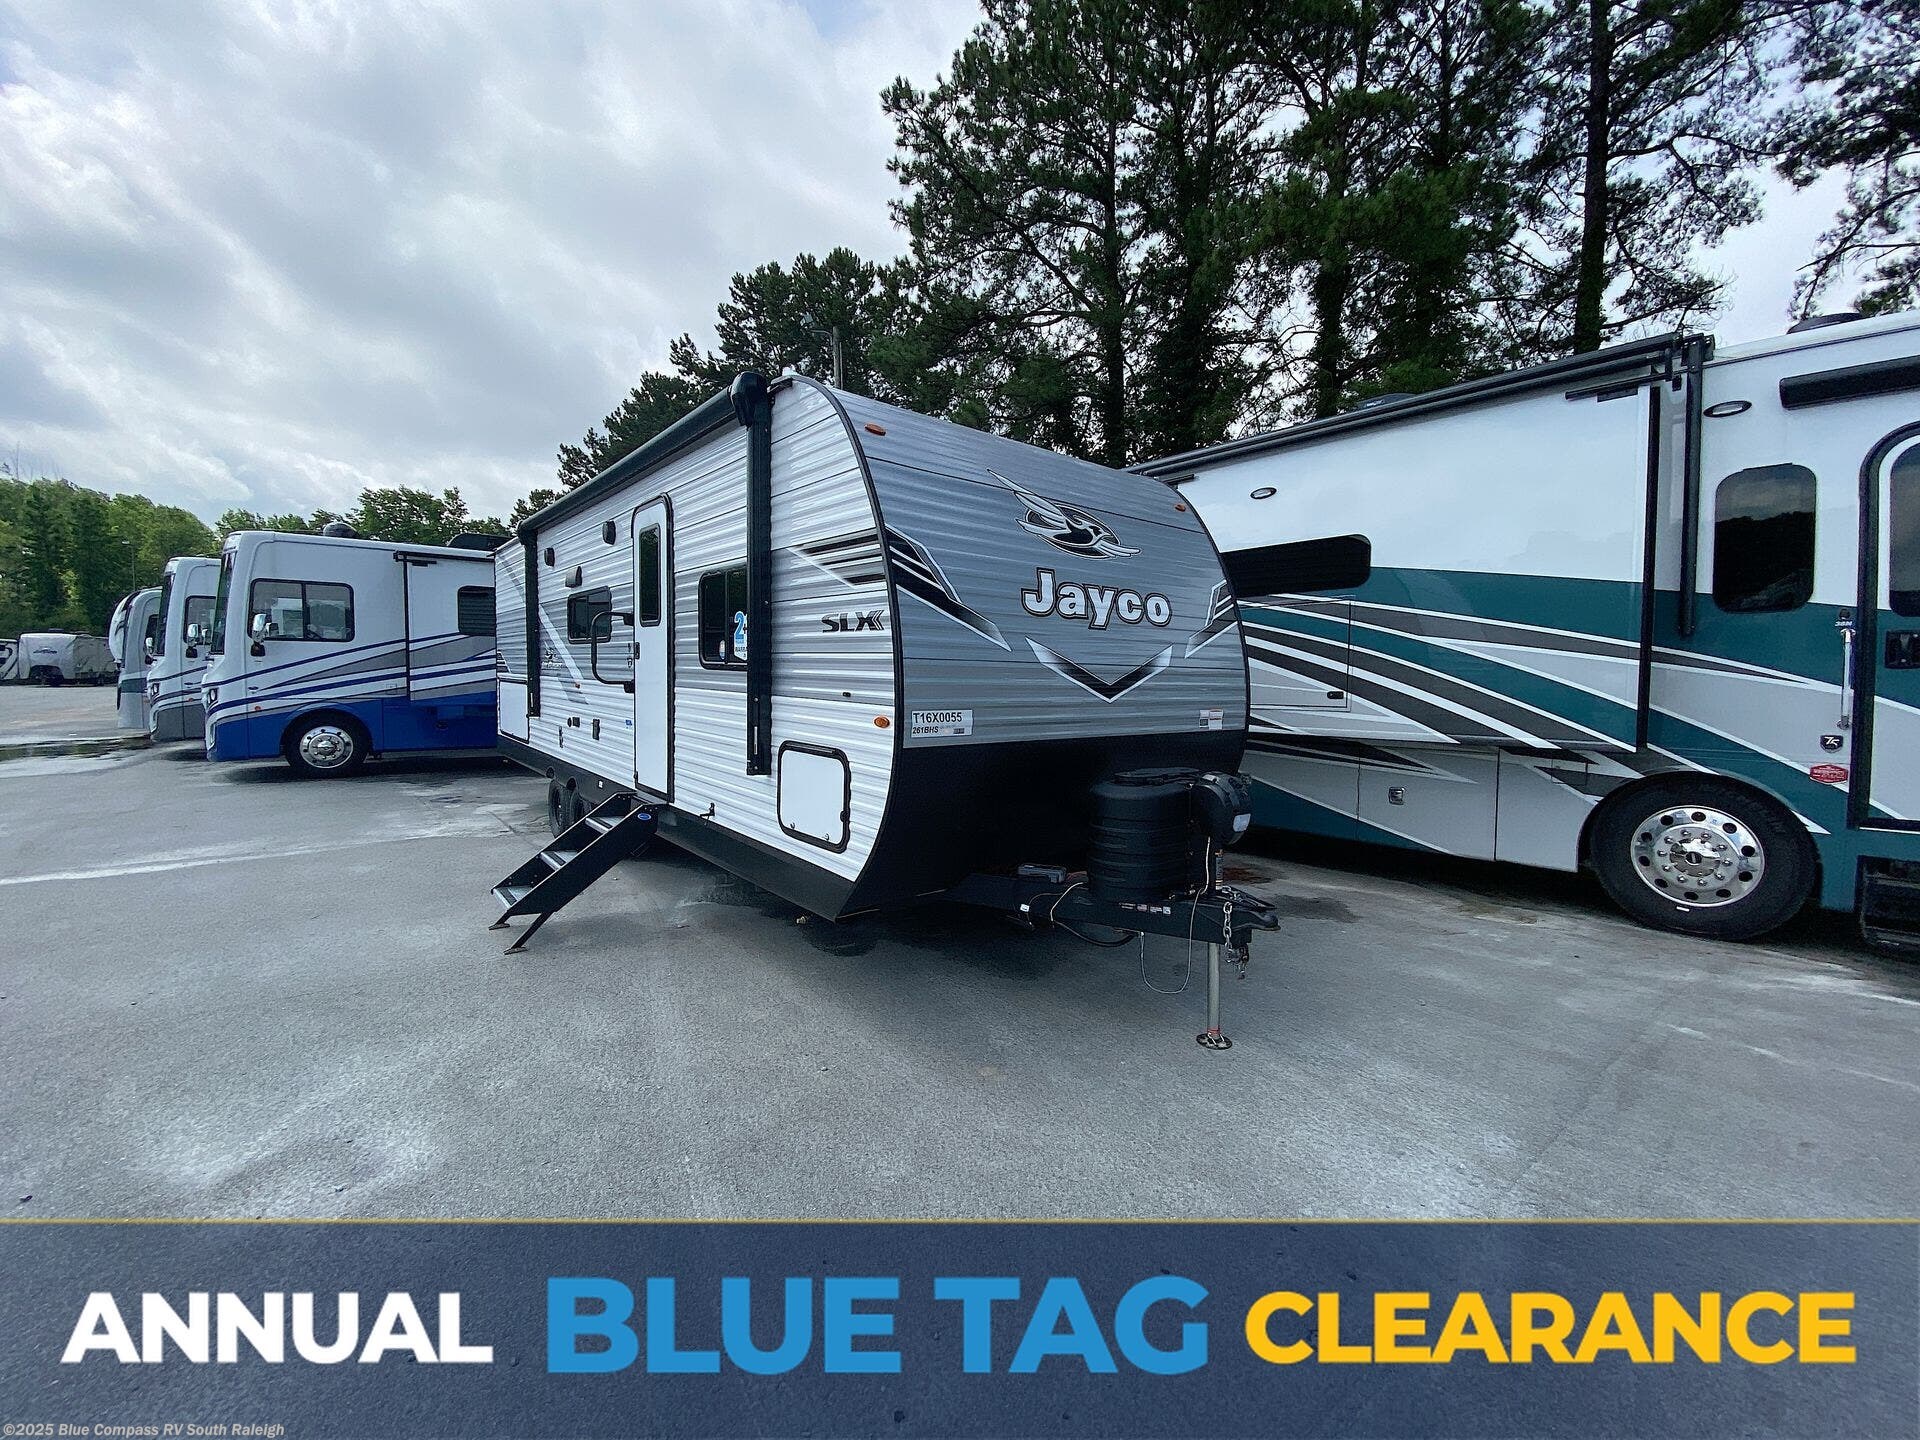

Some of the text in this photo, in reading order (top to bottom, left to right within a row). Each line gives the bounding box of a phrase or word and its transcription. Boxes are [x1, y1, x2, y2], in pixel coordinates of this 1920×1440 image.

[1021, 567, 1172, 630] Jayco
[821, 609, 884, 633] SLX
[913, 711, 963, 723] T16X0055
[912, 725, 939, 734] 261BHS
